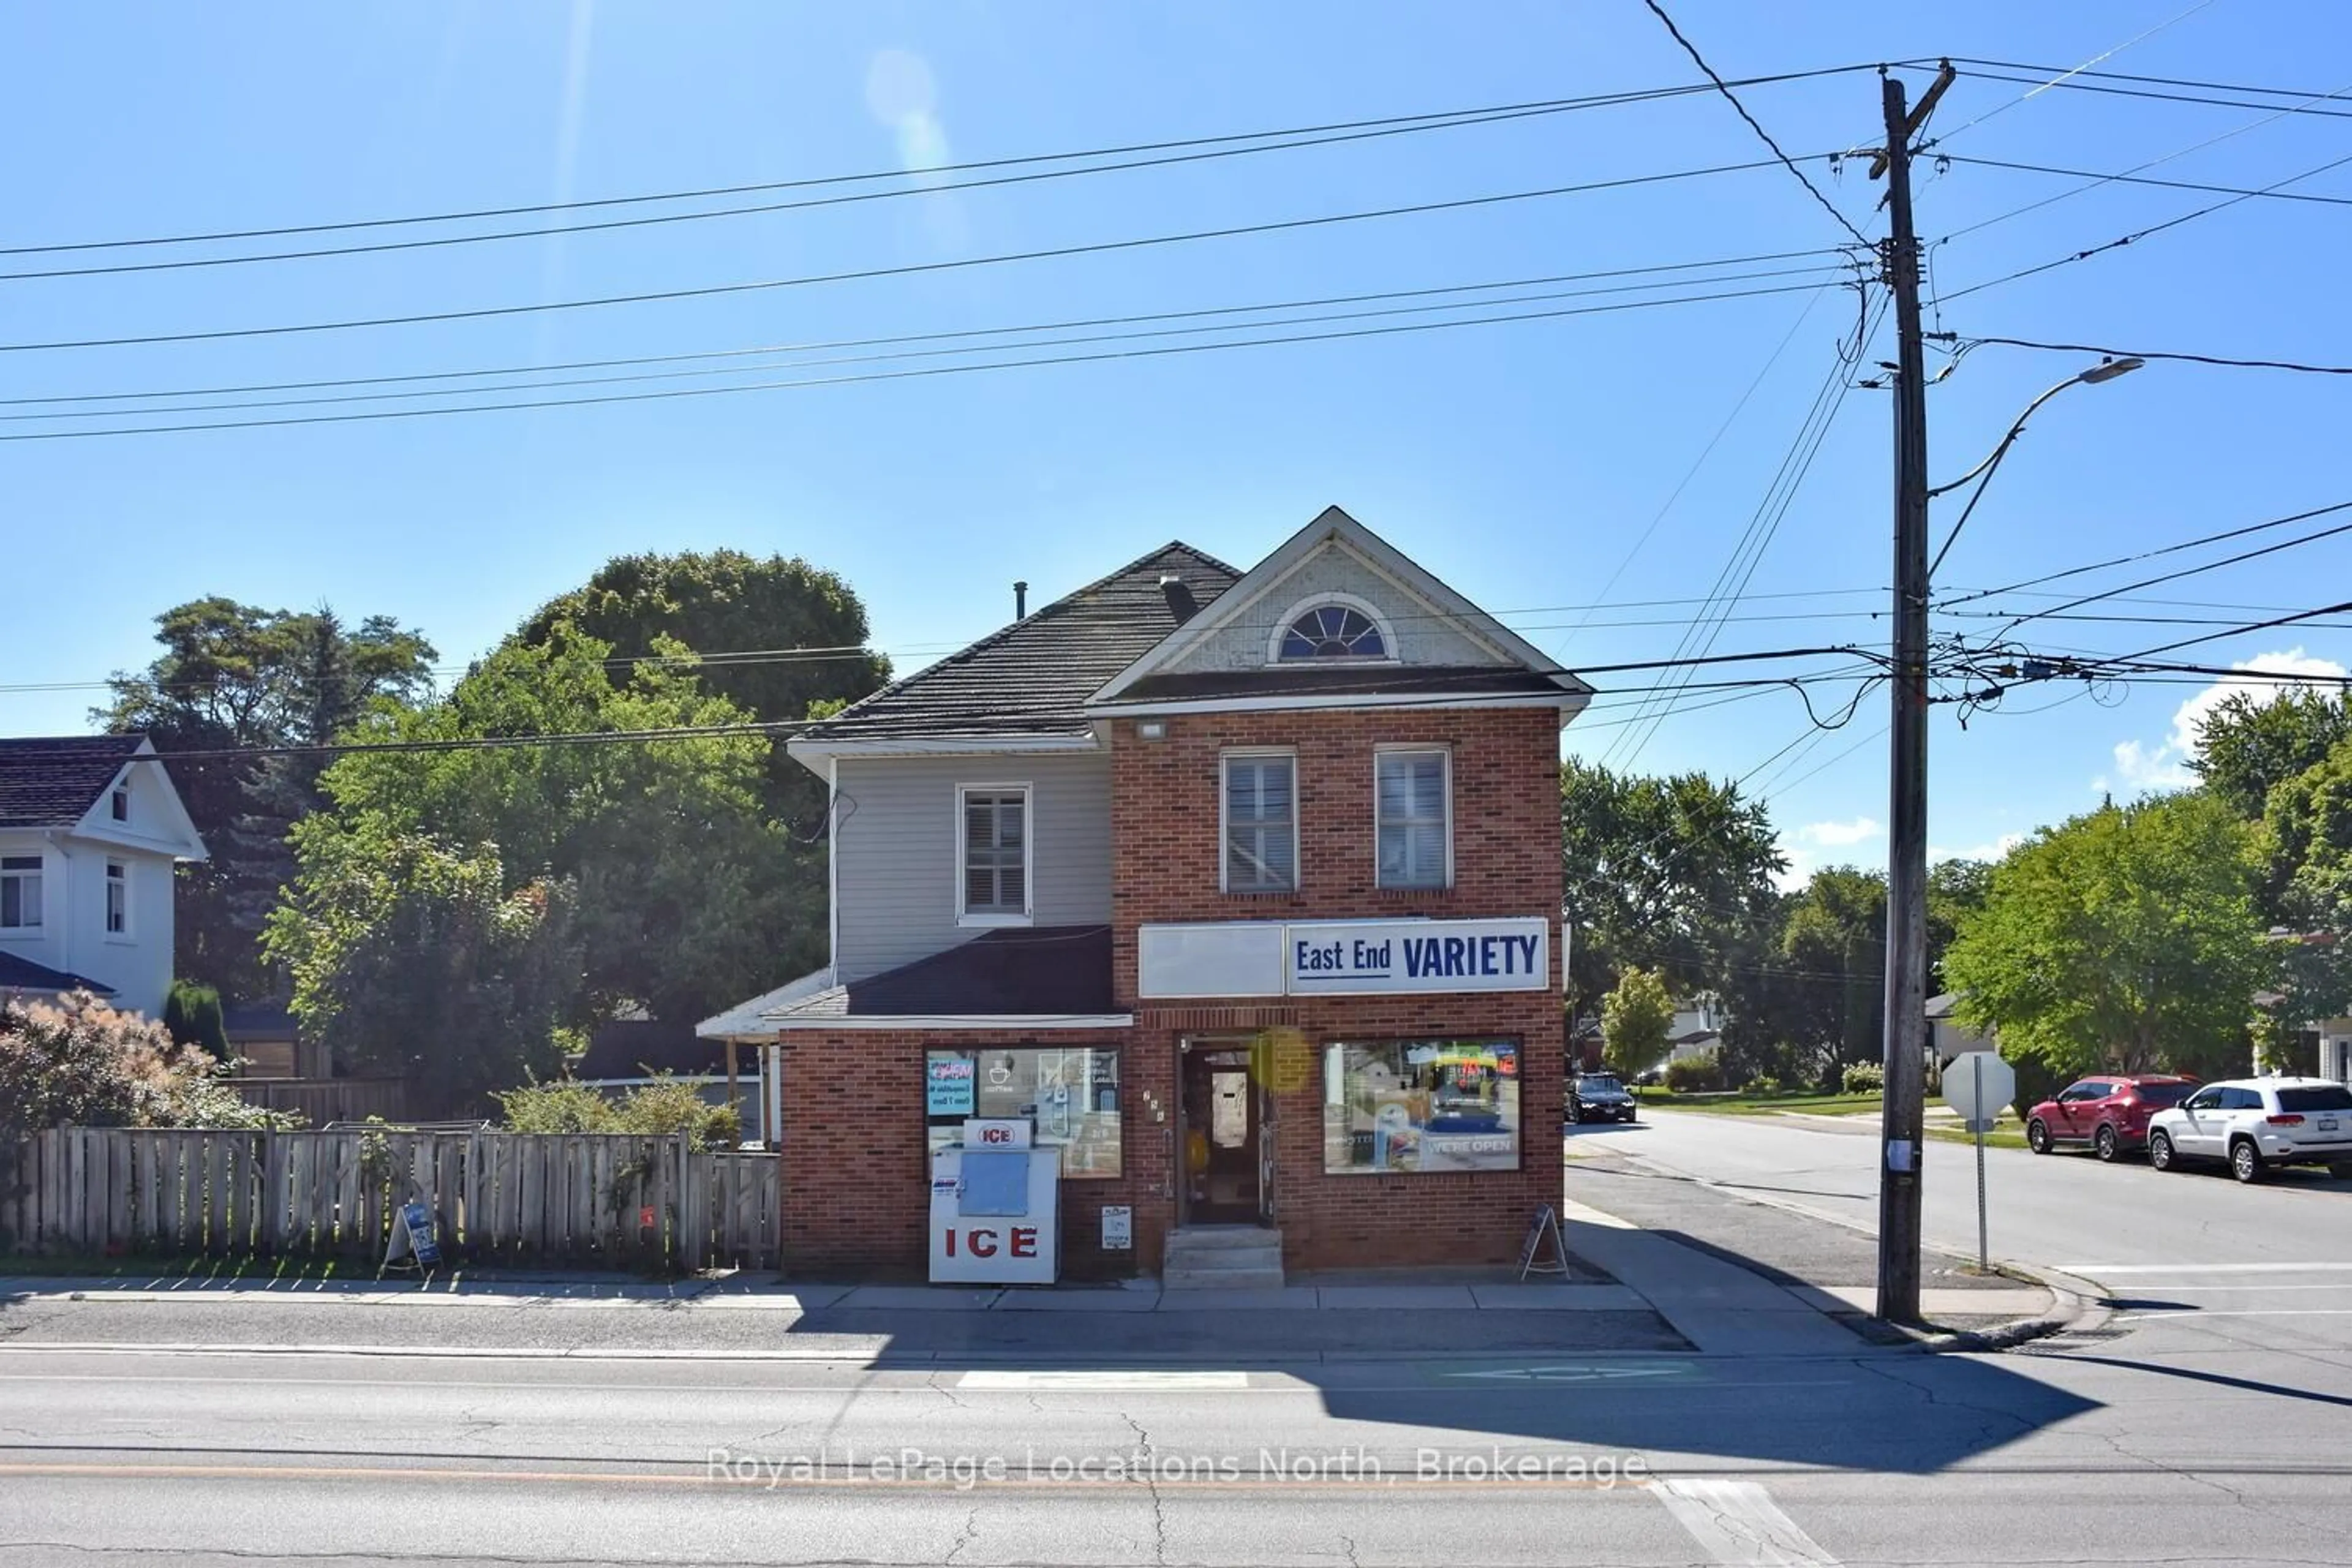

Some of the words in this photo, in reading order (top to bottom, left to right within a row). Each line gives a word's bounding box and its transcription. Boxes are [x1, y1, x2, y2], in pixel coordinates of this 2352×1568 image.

[1297, 941, 1343, 970] East
[1354, 939, 1391, 969] End
[1403, 935, 1539, 978] VARIETY
[983, 1129, 1010, 1144] ICE
[1472, 1140, 1512, 1152] OPEN
[946, 1227, 1038, 1258] ICE
